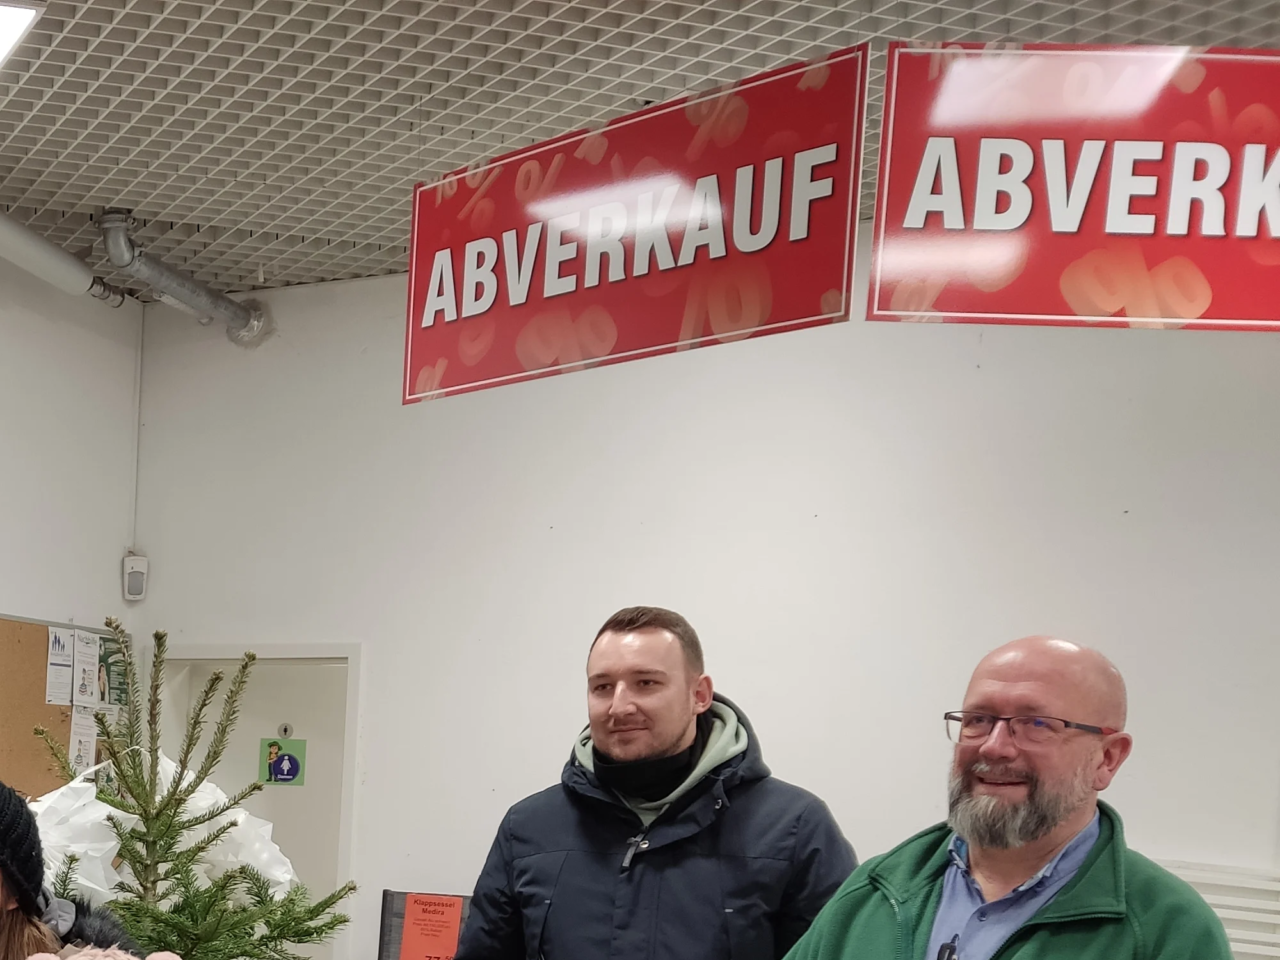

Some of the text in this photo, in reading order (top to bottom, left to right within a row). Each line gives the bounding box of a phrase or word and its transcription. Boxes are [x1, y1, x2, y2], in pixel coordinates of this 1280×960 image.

[421, 143, 838, 330] ABVERKAUF
[413, 899, 455, 909] Klappsessel
[421, 907, 445, 916] Medira
